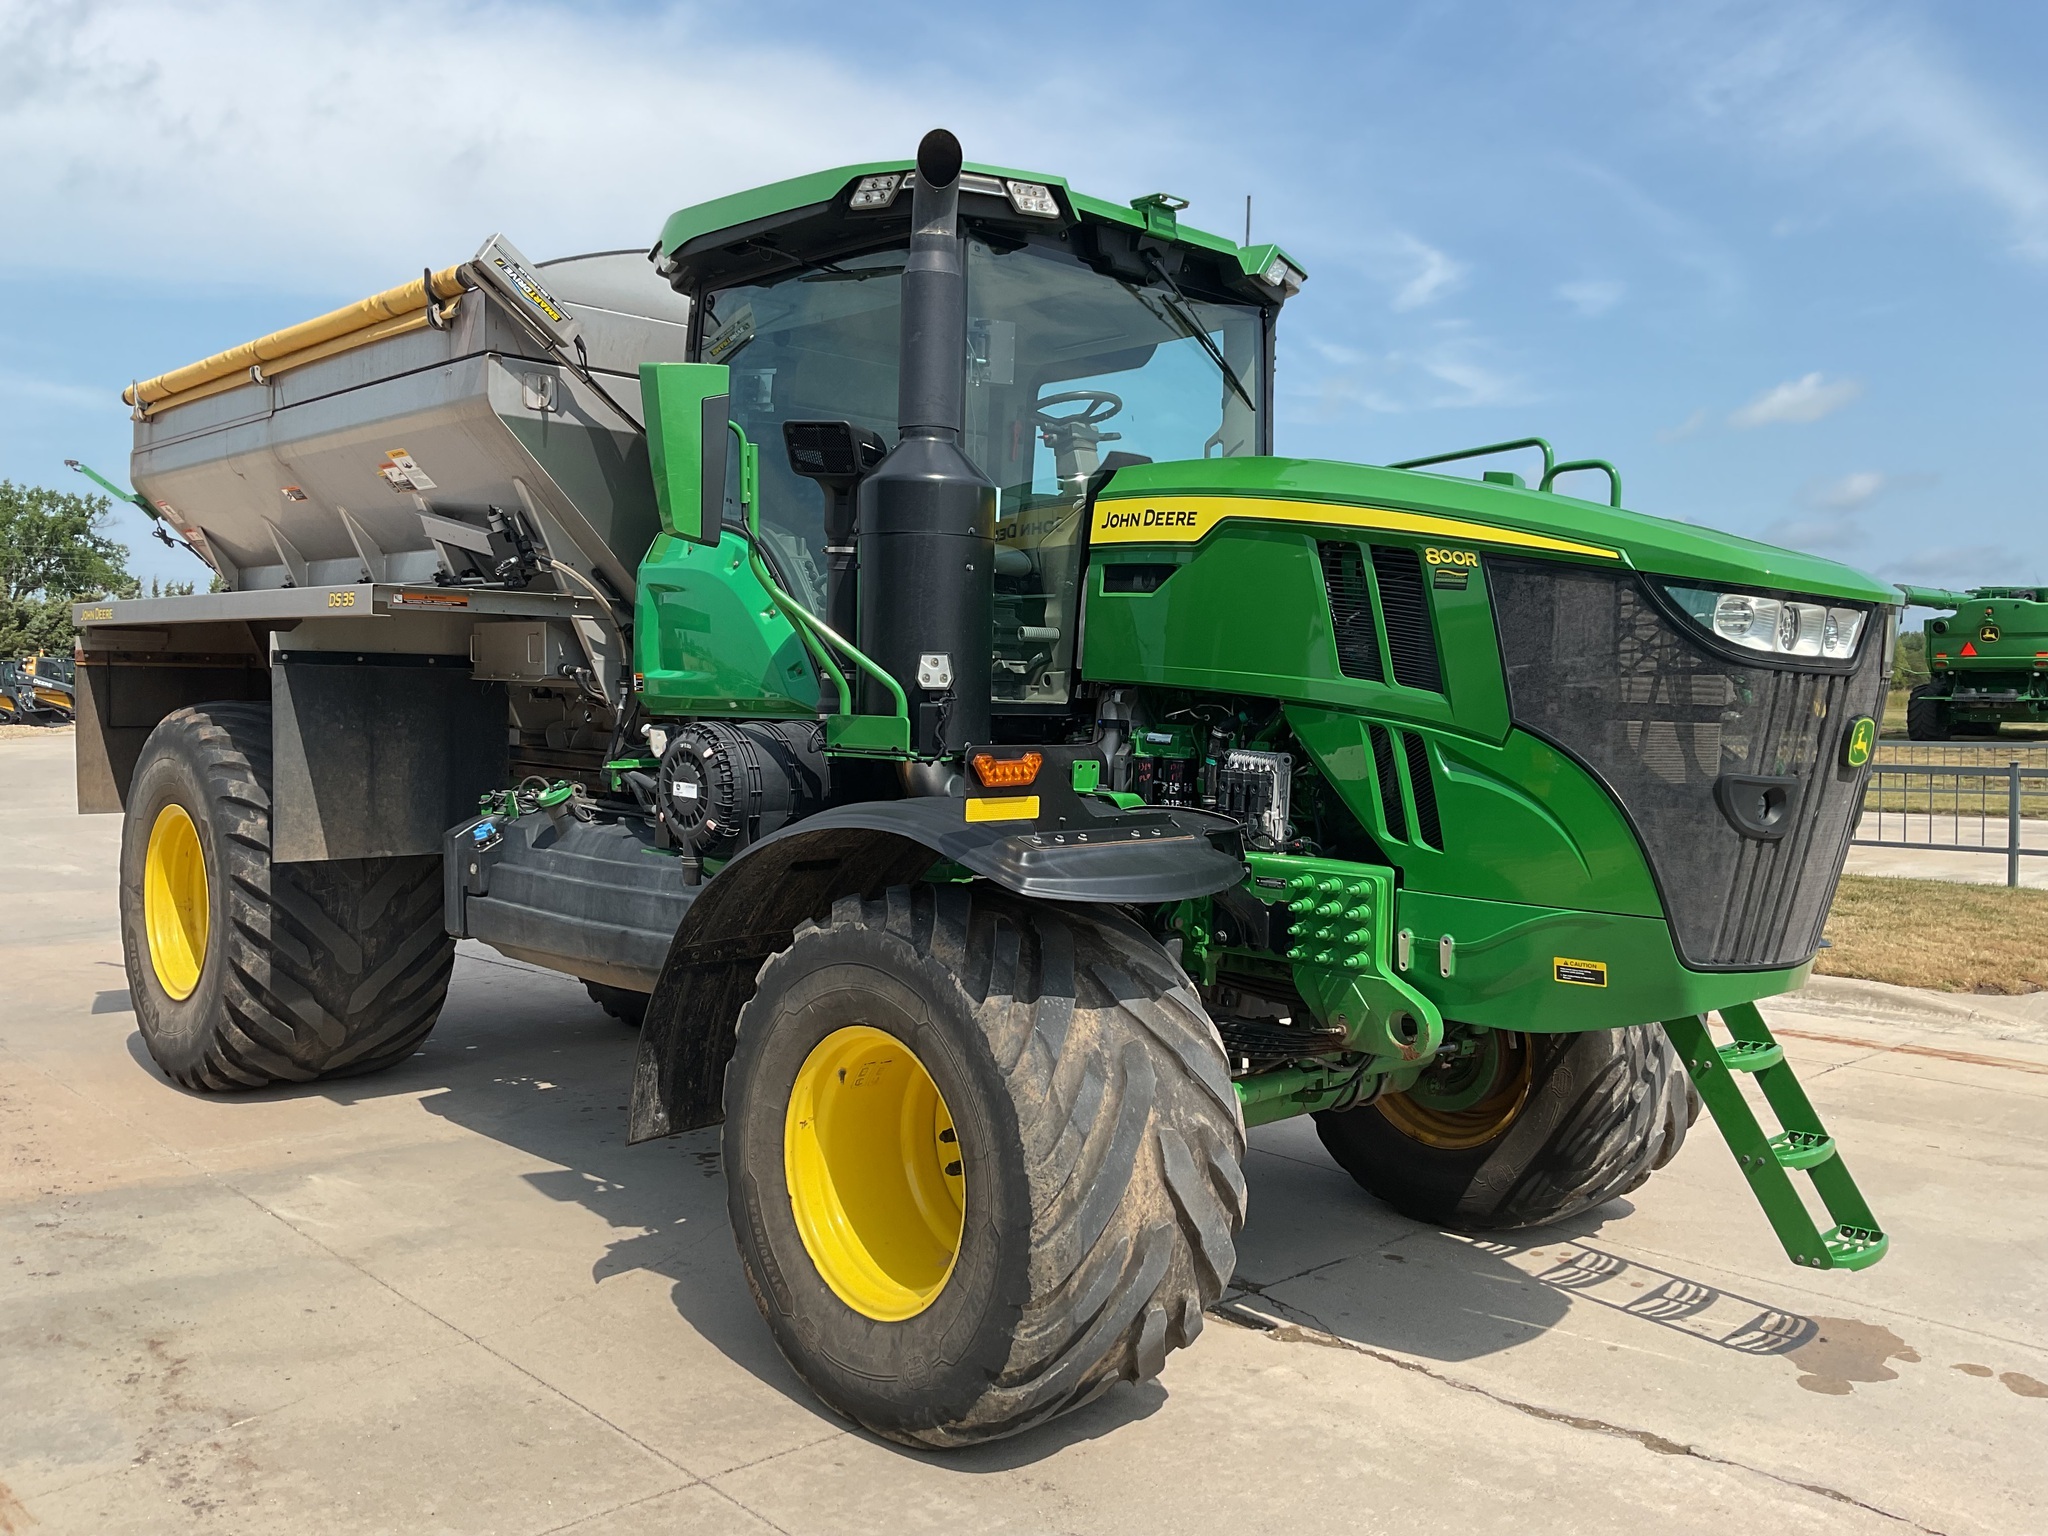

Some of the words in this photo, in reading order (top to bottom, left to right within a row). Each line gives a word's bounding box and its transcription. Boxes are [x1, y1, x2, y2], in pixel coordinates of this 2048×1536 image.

[502, 265, 561, 322] SMARTDRIVE
[1101, 511, 1141, 529] JOHN
[1143, 509, 1198, 527] DEERE
[1425, 547, 1479, 567] 800R
[328, 593, 341, 607] DS
[342, 592, 355, 606] 35
[1569, 961, 1597, 969] CAUTION
